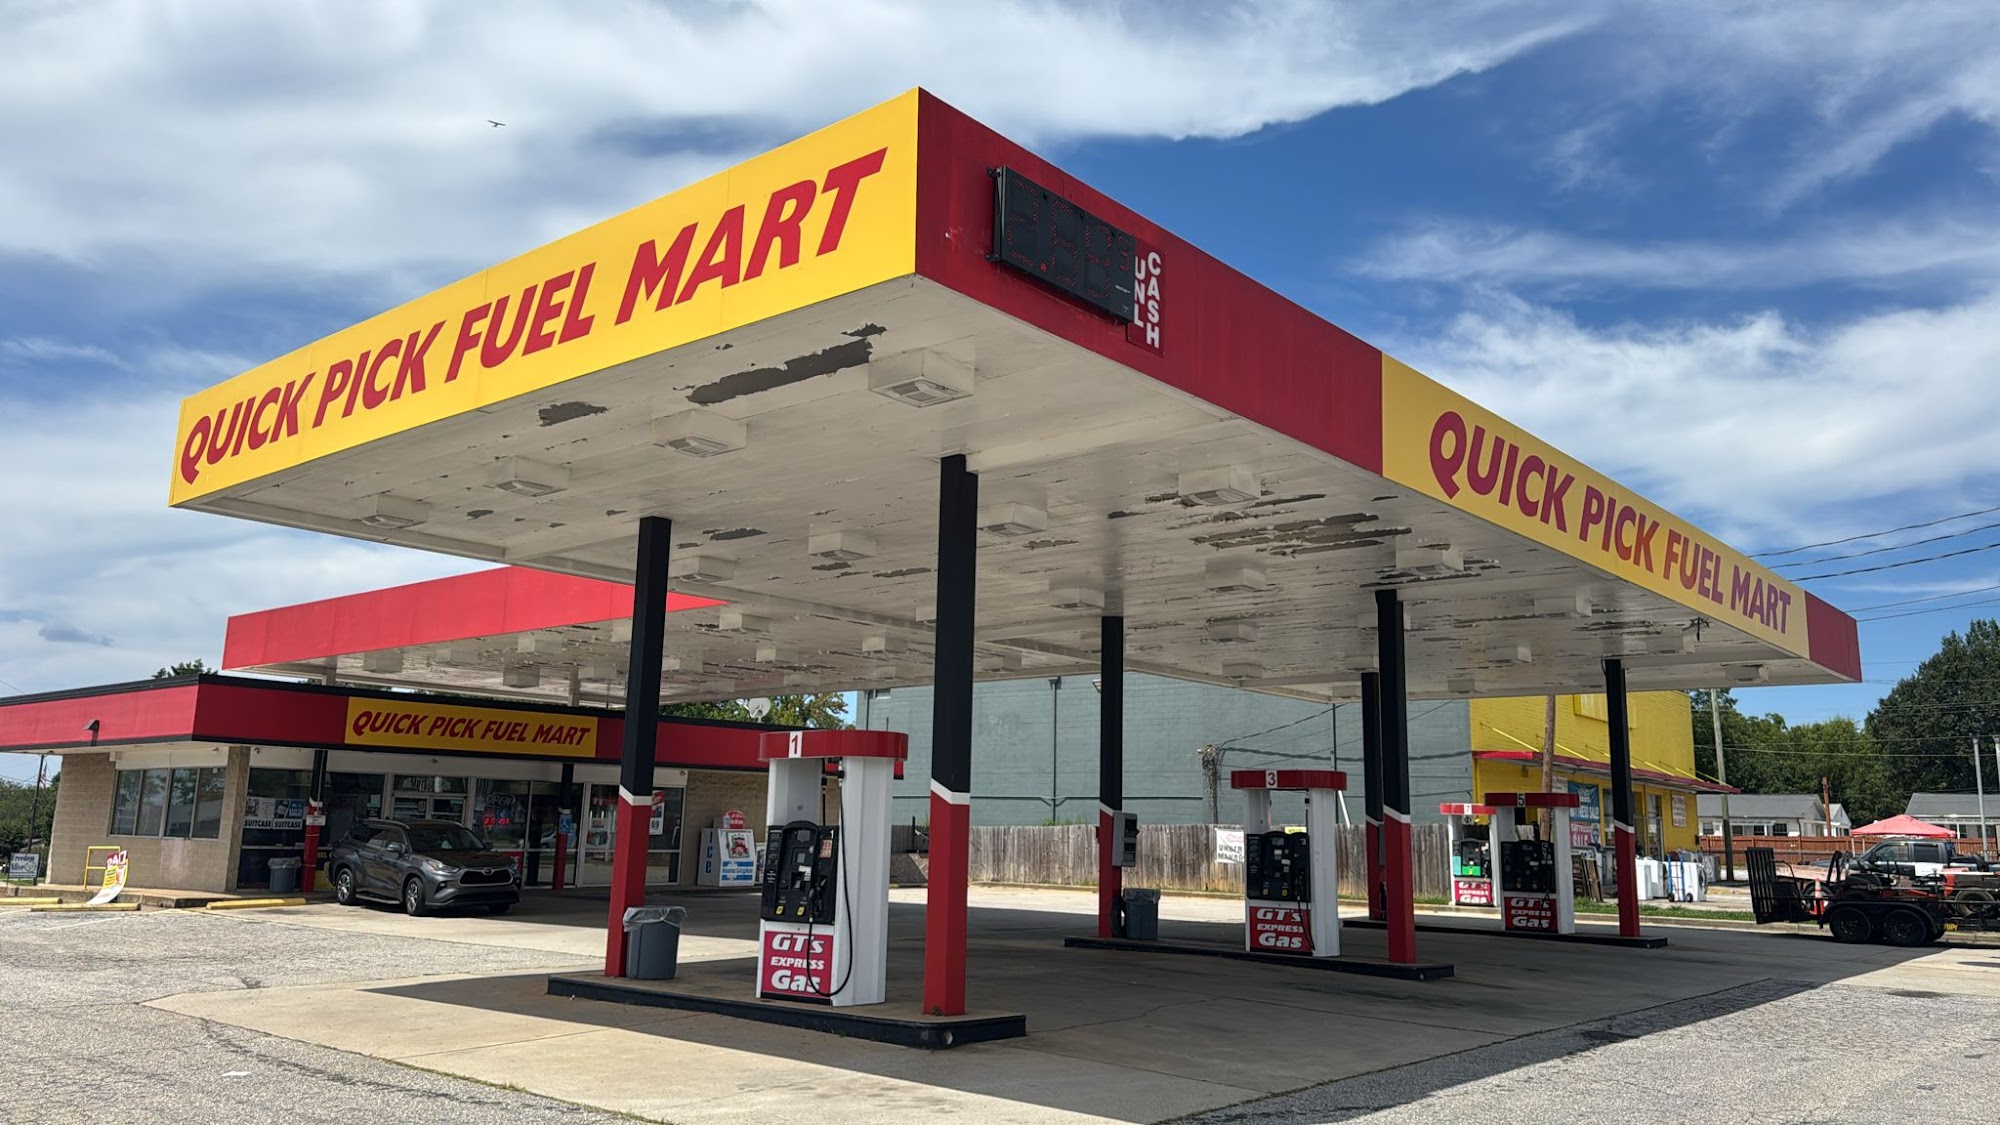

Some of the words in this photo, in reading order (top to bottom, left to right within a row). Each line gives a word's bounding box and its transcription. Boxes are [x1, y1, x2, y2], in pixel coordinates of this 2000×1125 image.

[1133, 255, 1147, 328] UNL
[1146, 251, 1161, 349] CASH
[181, 372, 316, 484] QUICK
[312, 320, 445, 428] PICK
[445, 262, 597, 383] FUEL
[614, 147, 888, 326] MART
[1429, 411, 1575, 532] QUICK
[1579, 485, 1660, 573] PICK
[1663, 528, 1723, 605] FUEL
[1730, 565, 1791, 634] MART
[352, 710, 428, 736] QUICK
[427, 716, 482, 738] PICK
[480, 720, 530, 742] FUEL
[531, 724, 592, 746] MART
[791, 734, 799, 755] 1
[1268, 772, 1276, 786] 3
[1518, 794, 1525, 807] 5
[1466, 805, 1471, 813] 7
[274, 820, 301, 829] SUITCASE
[830, 829, 835, 839] 1
[1459, 894, 1488, 904] Gas
[1510, 897, 1549, 908] GT's
[1256, 908, 1303, 922] GT's
[1512, 916, 1550, 928] Gas
[1256, 923, 1304, 933] EXPRESS
[771, 933, 825, 954] GT's
[1259, 932, 1303, 949] Gas
[770, 956, 825, 970] EXPRESS
[771, 969, 821, 993] Gas
